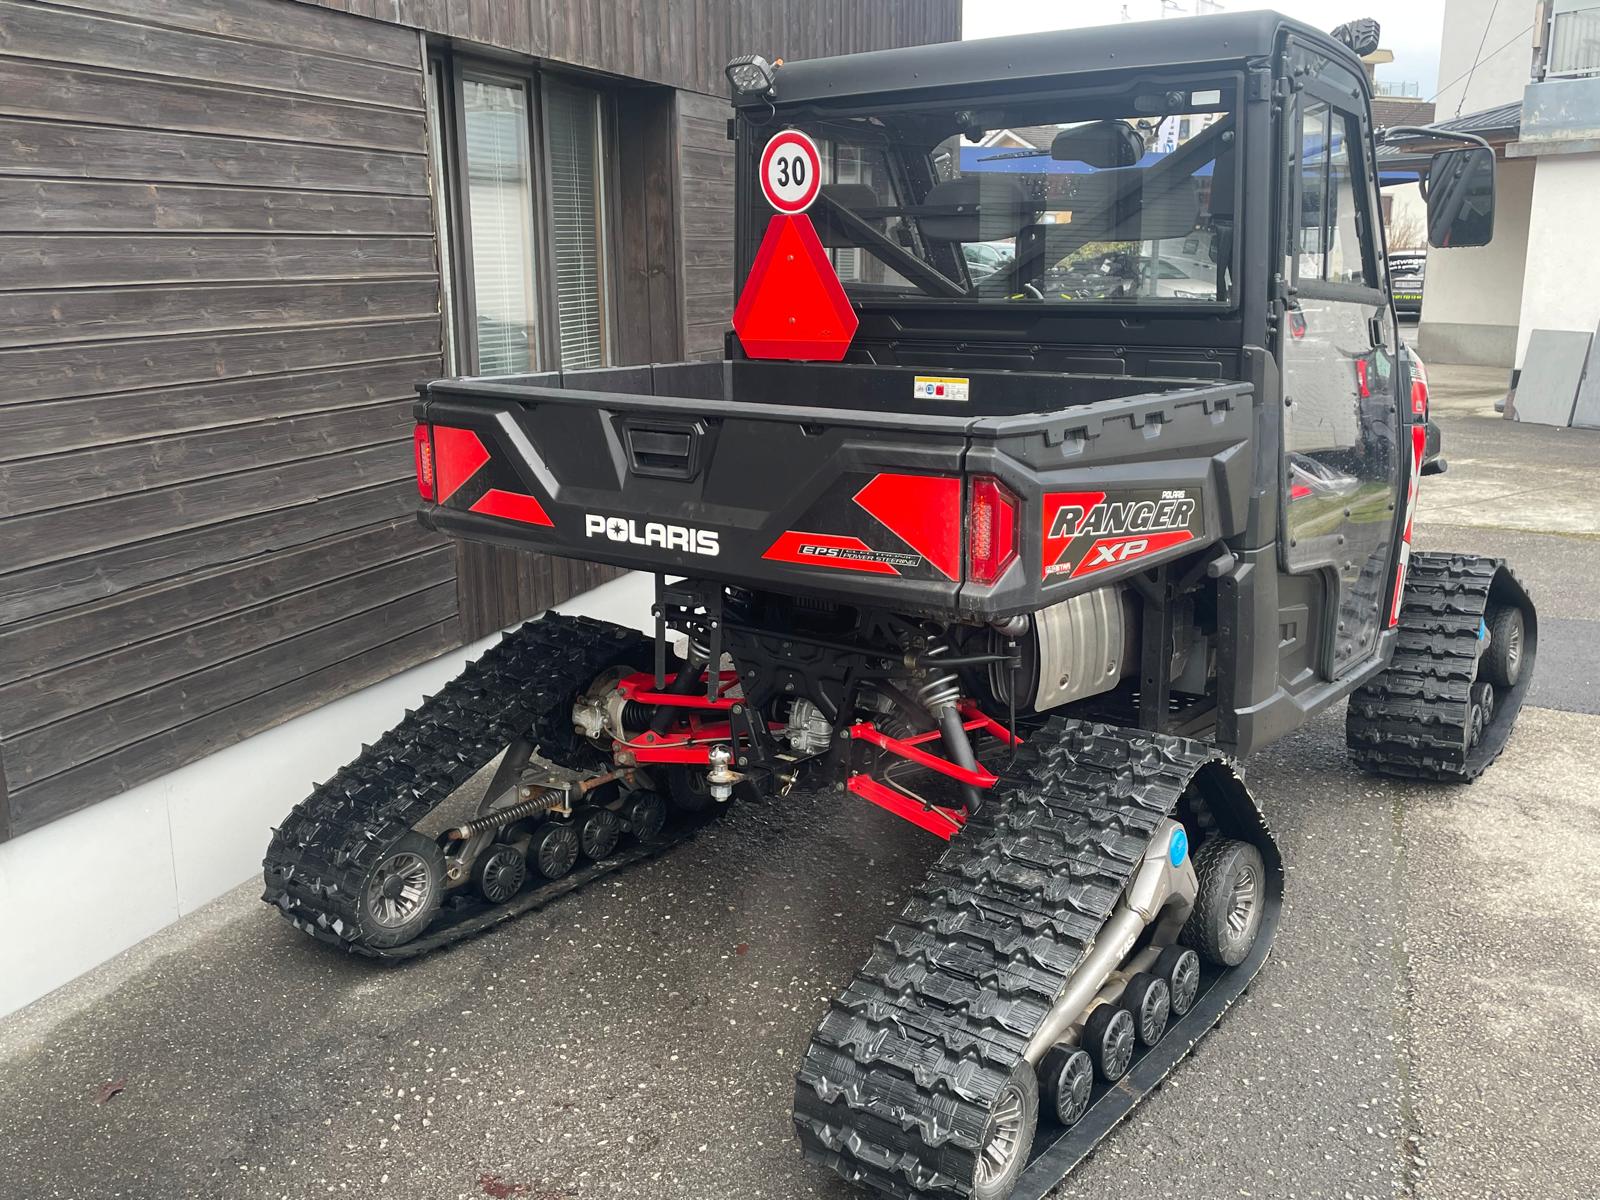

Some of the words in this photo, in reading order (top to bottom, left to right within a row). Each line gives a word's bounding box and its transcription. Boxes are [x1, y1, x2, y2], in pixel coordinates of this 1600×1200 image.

[777, 156, 806, 187] 30
[1162, 490, 1186, 499] POLARIS
[1048, 499, 1195, 539] RANGER
[585, 513, 720, 557] POLARIS
[802, 546, 841, 557] EPS
[843, 552, 874, 561] POWER
[876, 556, 917, 565] STEERING
[1087, 539, 1149, 567] XP
